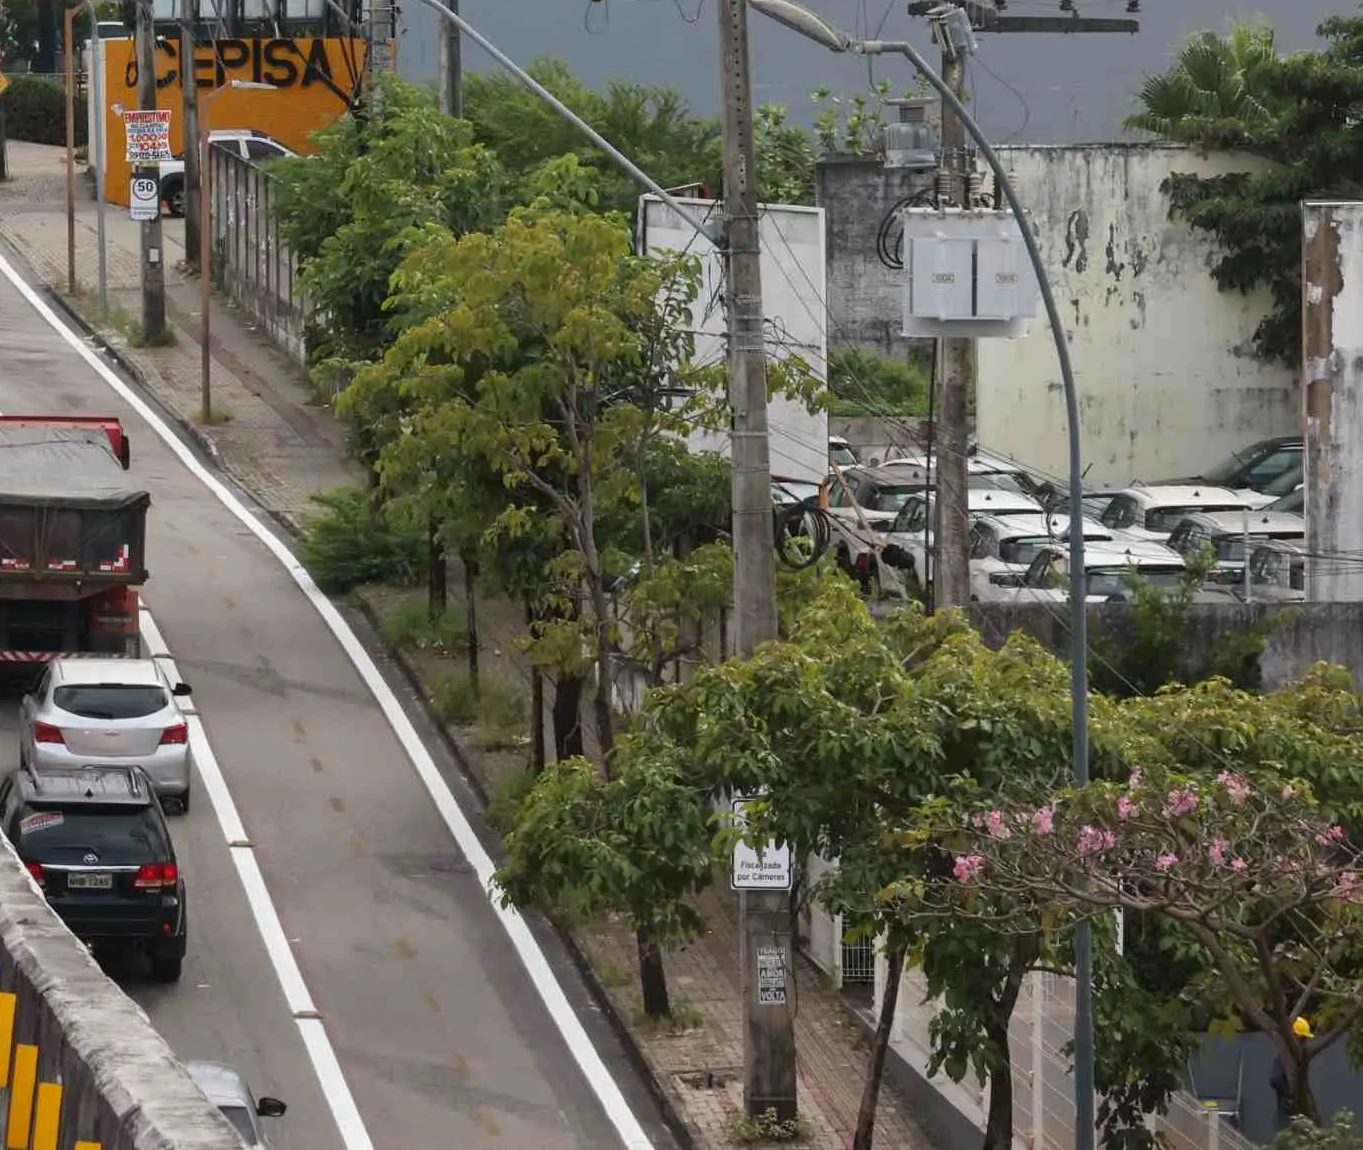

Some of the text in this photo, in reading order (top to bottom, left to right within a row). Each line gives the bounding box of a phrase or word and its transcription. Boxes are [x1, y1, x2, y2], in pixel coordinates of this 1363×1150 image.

[155, 38, 334, 89] CEPISA
[138, 181, 154, 192] 50
[740, 860, 782, 870] Fiscazada
[737, 873, 751, 882] por
